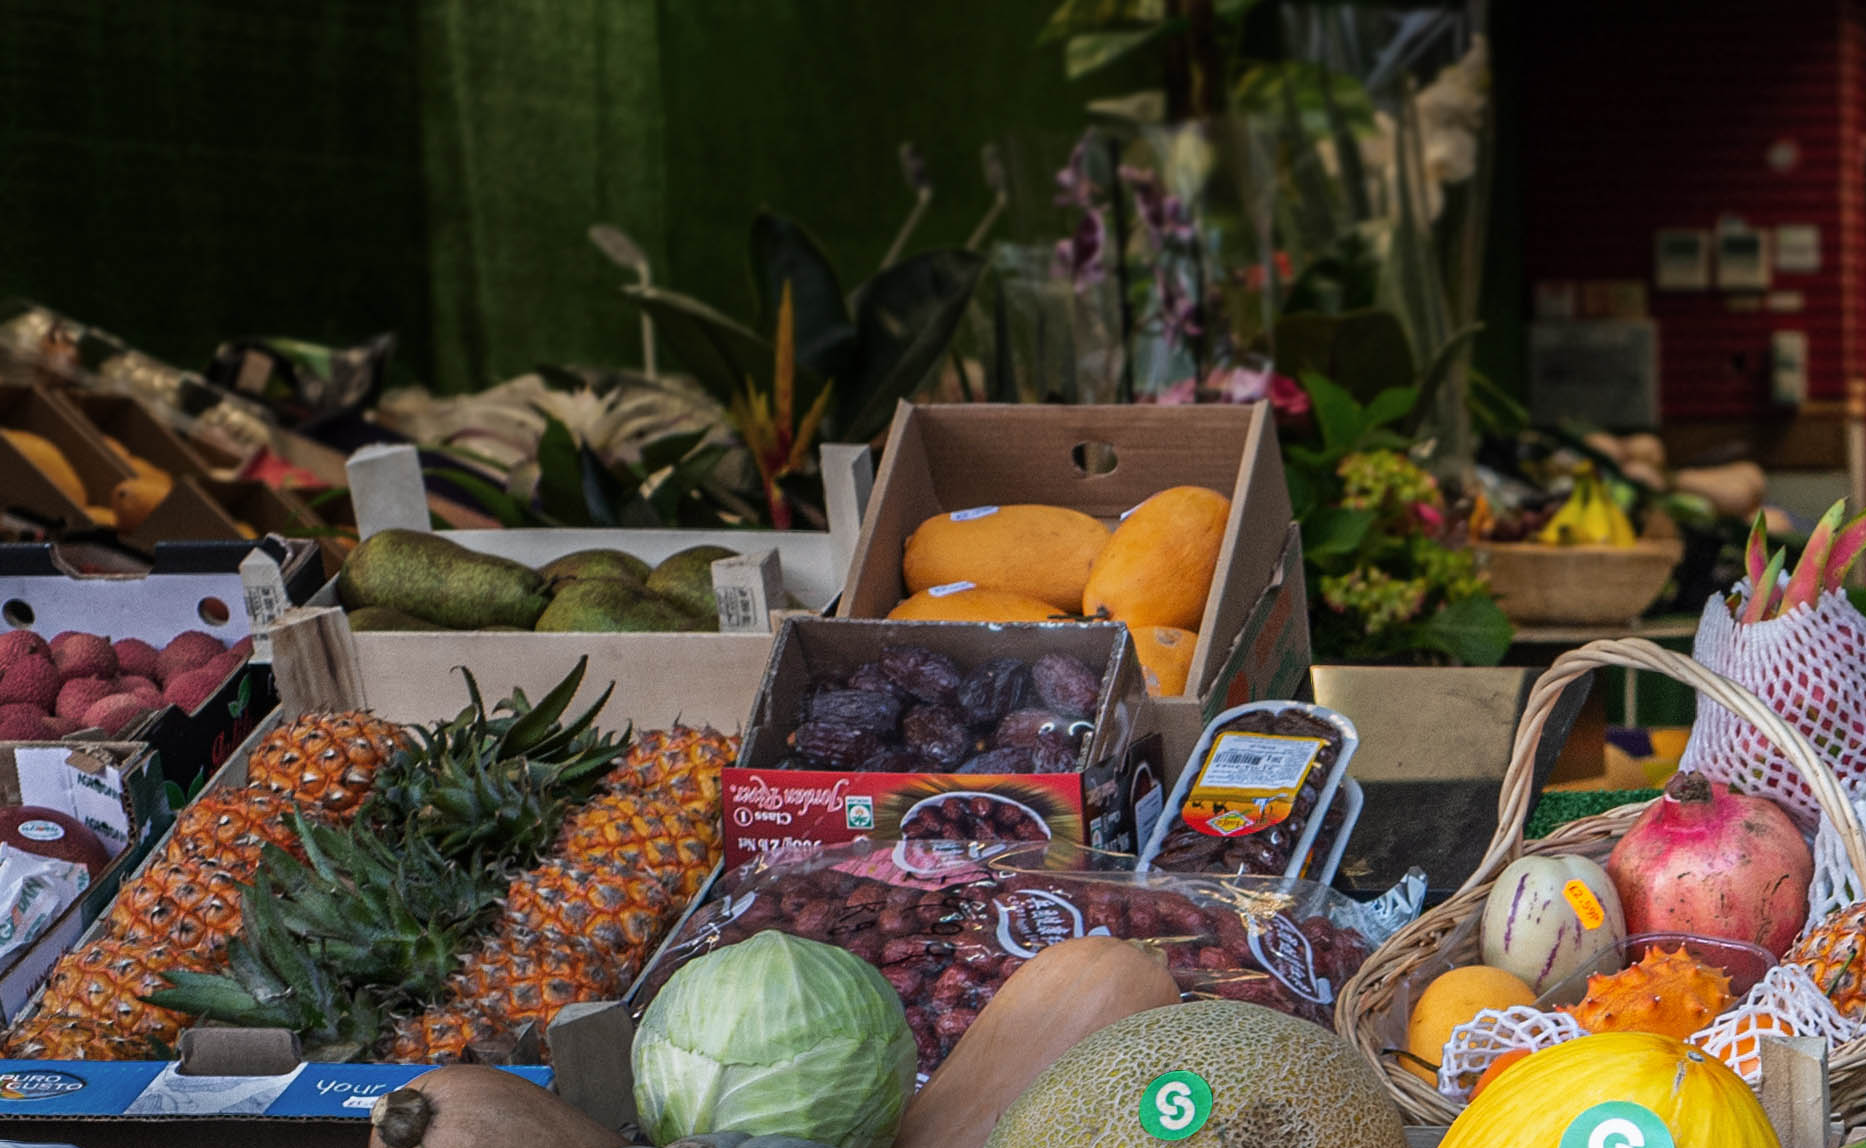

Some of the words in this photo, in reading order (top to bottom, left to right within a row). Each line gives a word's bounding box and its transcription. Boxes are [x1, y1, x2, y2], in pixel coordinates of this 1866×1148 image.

[784, 778, 850, 816] Jordan
[754, 811, 792, 825] Class
[0, 1074, 62, 1083] PURO
[6, 1082, 84, 1090] GUSTO
[316, 1079, 387, 1096] your
